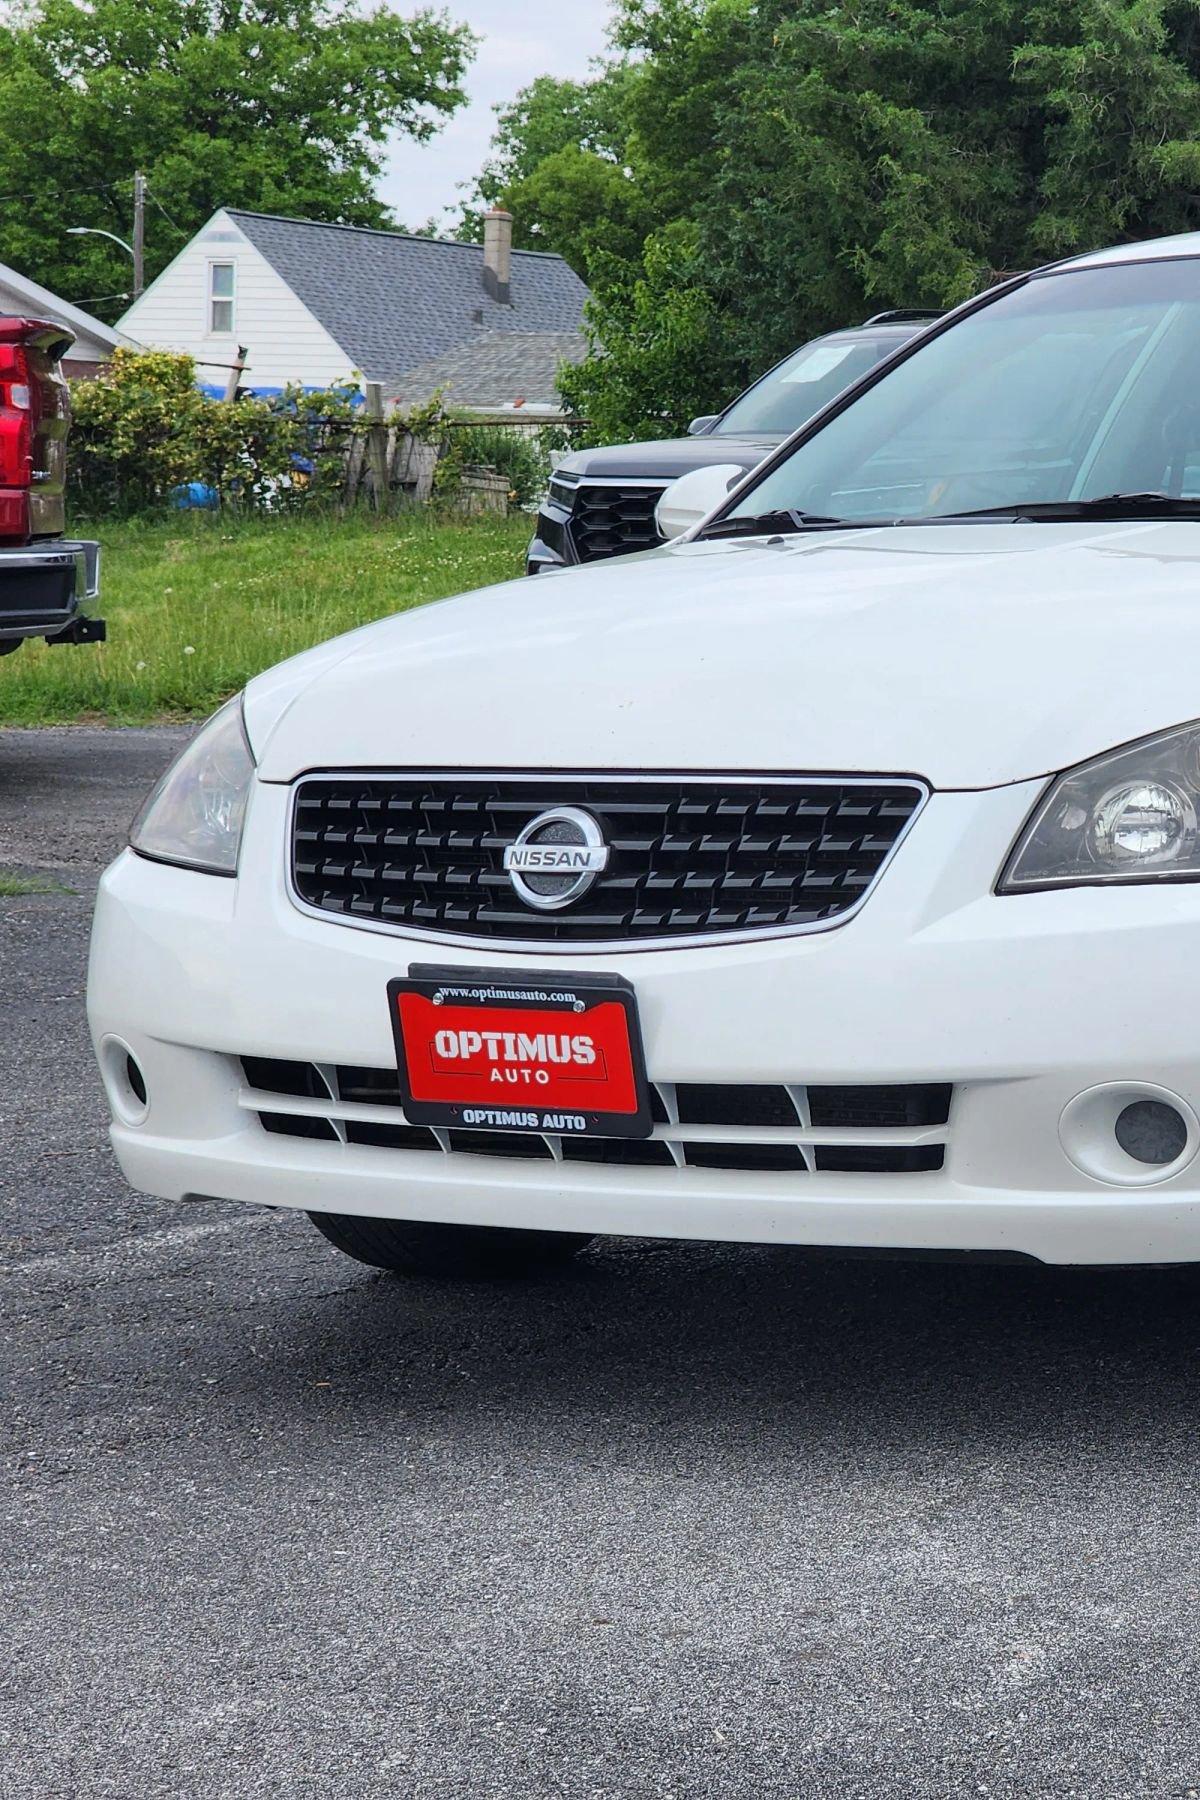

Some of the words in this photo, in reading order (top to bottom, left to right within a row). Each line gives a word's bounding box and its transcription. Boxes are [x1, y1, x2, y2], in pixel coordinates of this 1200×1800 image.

[509, 850, 592, 867] NISSAN
[438, 986, 577, 1002] www.optimusauto.com
[434, 1030, 597, 1065] OPTIMUS
[490, 1067, 550, 1085] AUTO
[462, 1109, 540, 1127] OPTIMUS
[542, 1113, 587, 1130] AUTO
